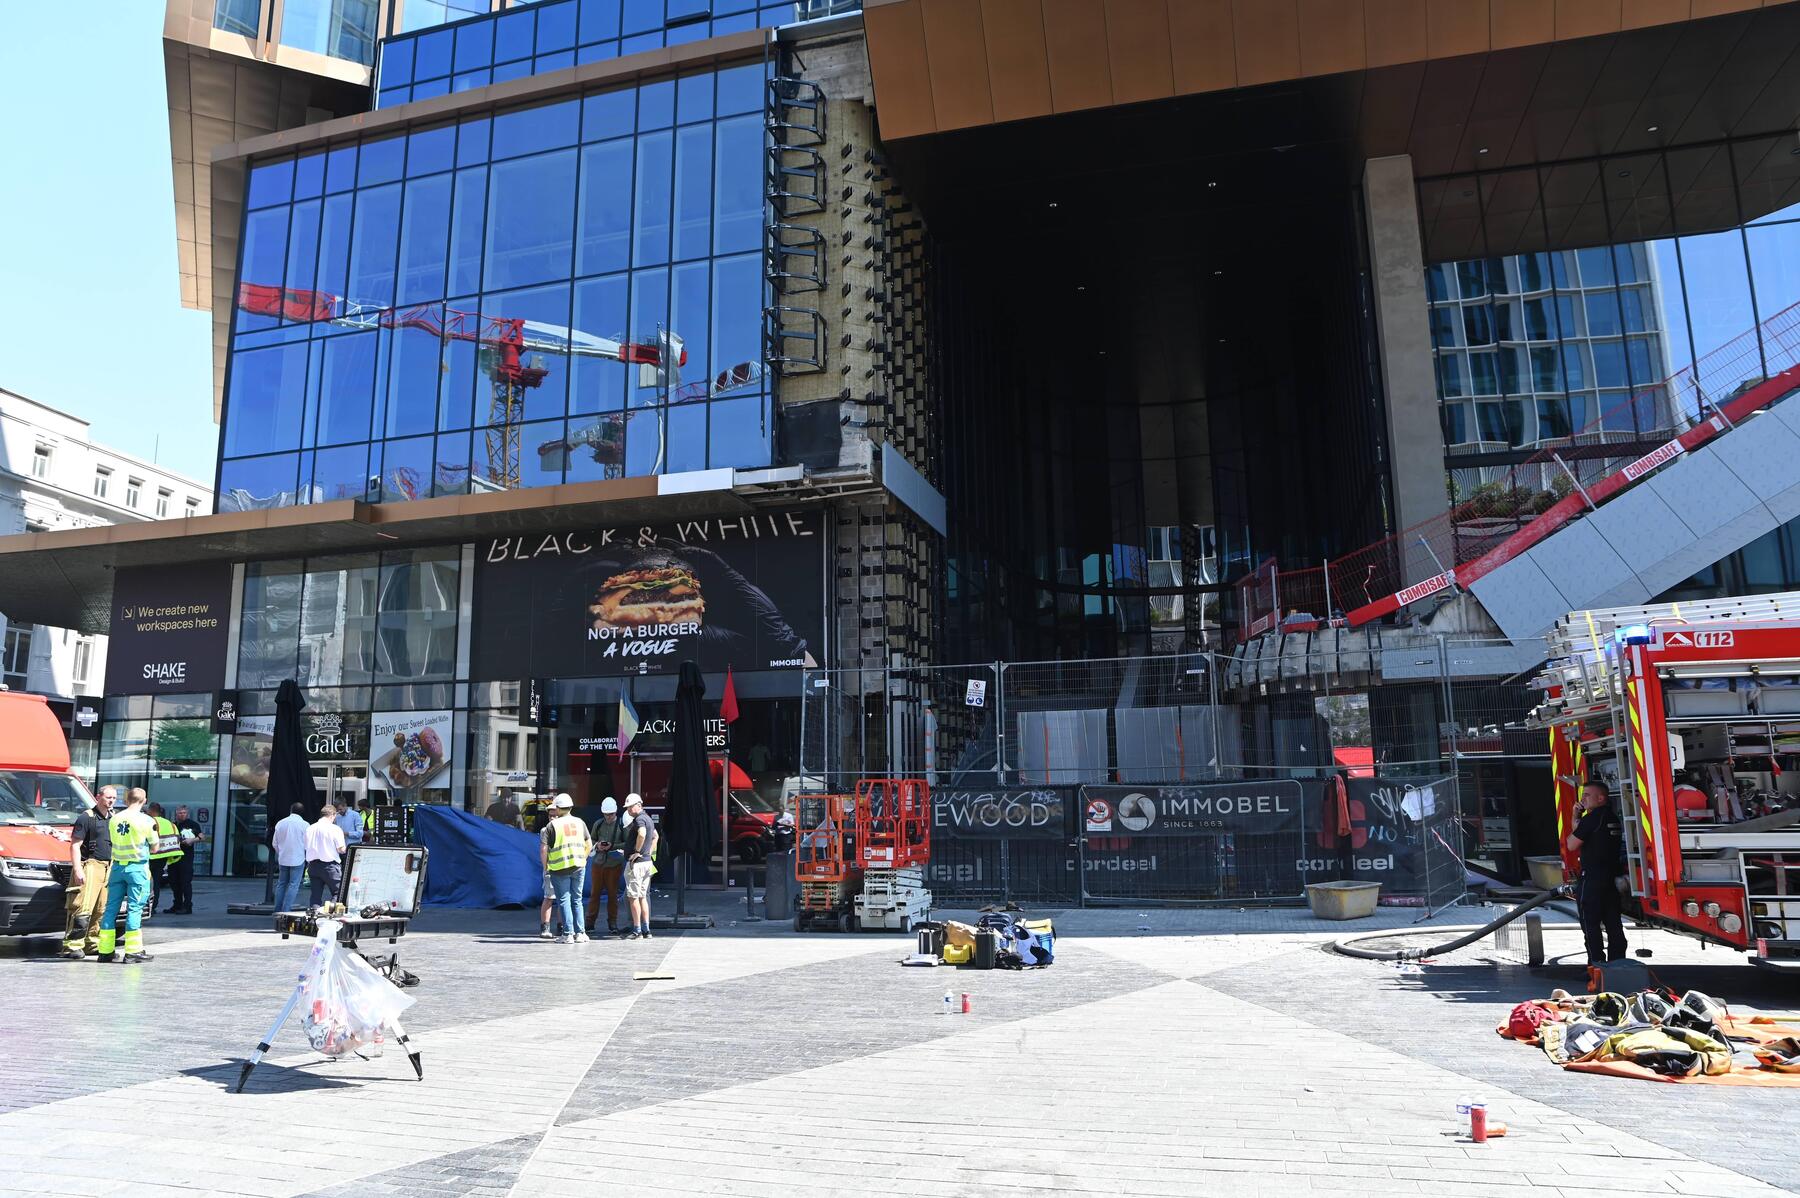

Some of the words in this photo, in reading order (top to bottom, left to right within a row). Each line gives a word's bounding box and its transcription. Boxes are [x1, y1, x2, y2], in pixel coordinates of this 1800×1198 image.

[1625, 440, 1681, 479] COMBISAFE
[486, 528, 616, 563] BLACK
[637, 526, 658, 549] &
[1398, 573, 1451, 604] COMBISAF
[138, 606, 154, 618] We
[156, 604, 187, 617] create
[188, 604, 209, 615] new
[136, 619, 194, 633] workspaces
[195, 617, 218, 629] here
[588, 626, 619, 641] NOT
[623, 625, 634, 638] A
[637, 621, 703, 638] BURGER,
[1704, 631, 1732, 646] 112
[602, 641, 618, 659] A
[621, 638, 679, 658] VOGUE
[142, 662, 187, 679] SHAKE
[770, 658, 805, 668] IMMOBEL
[217, 709, 236, 720] Galet
[374, 723, 397, 737] Enjoy
[399, 723, 409, 732] our
[410, 719, 425, 729] Sweet
[305, 733, 351, 754] Galet
[1162, 795, 1290, 817] IMMOBEL
[1163, 819, 1195, 829] SINCE
[1198, 818, 1224, 828] 1863
[1368, 825, 1398, 842] NO
[1065, 855, 1157, 872] cordeel
